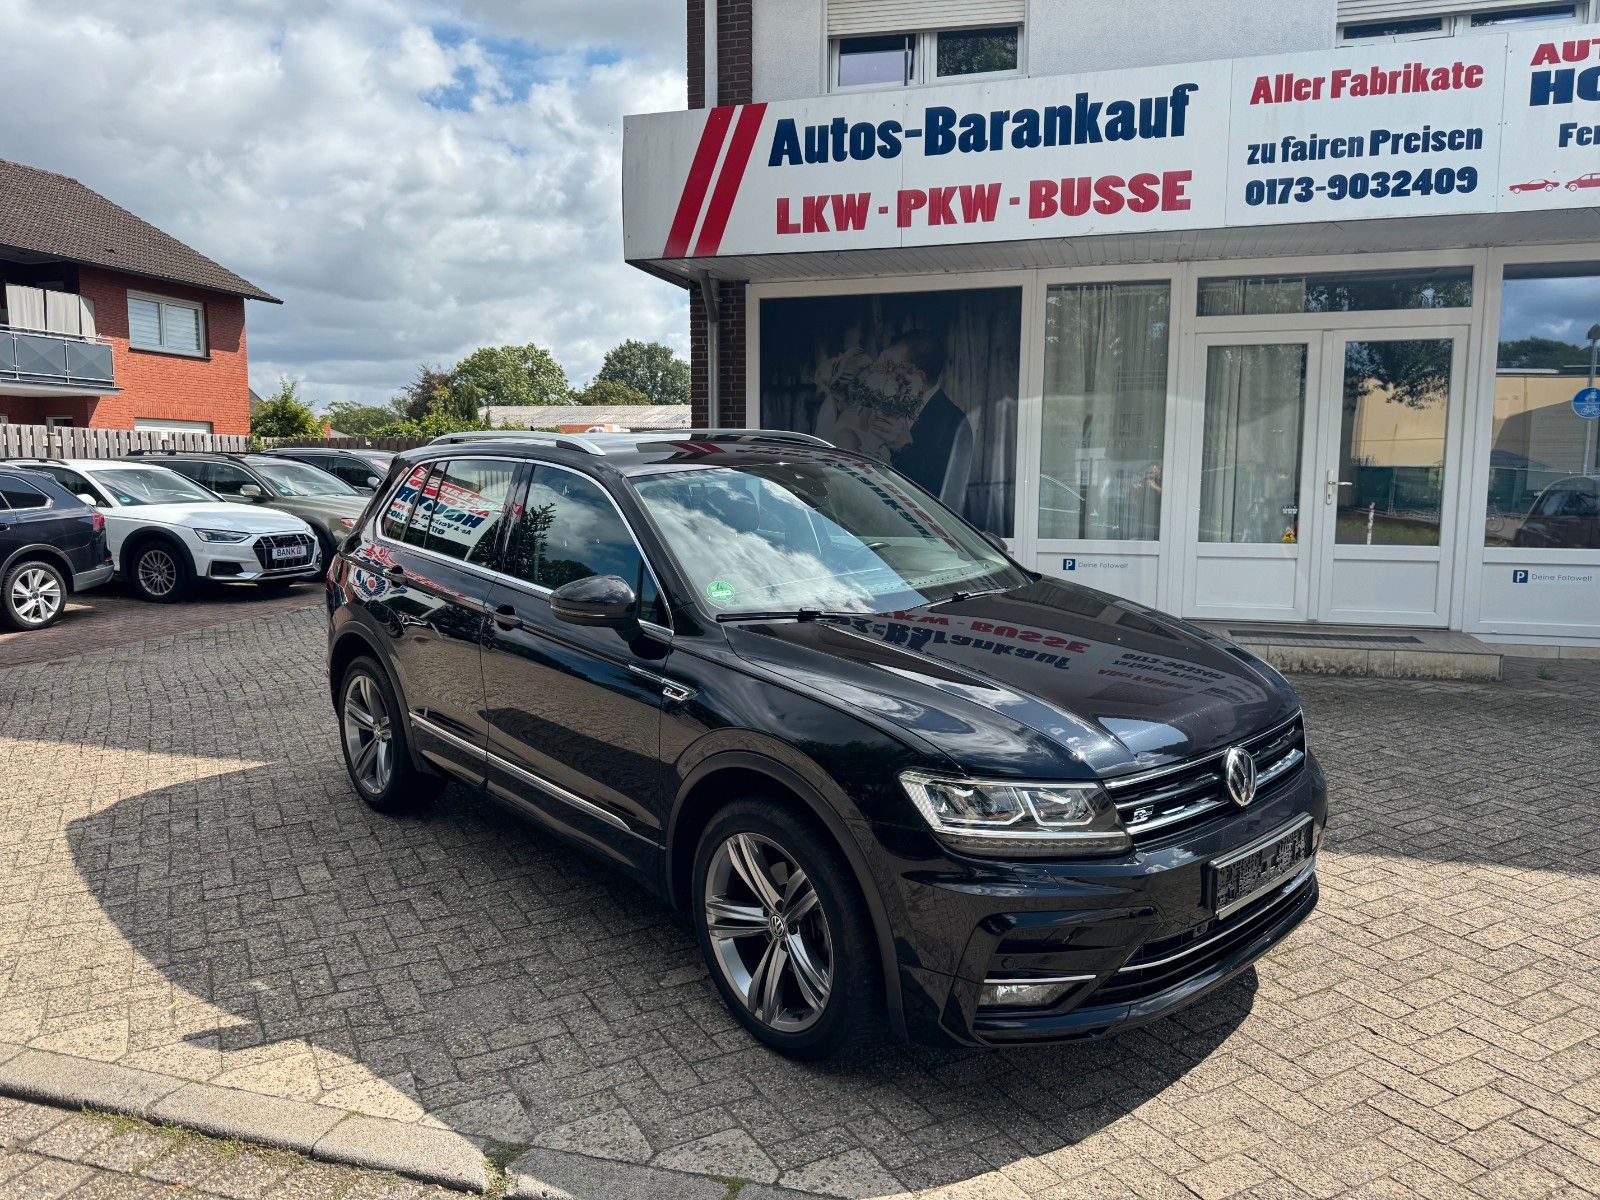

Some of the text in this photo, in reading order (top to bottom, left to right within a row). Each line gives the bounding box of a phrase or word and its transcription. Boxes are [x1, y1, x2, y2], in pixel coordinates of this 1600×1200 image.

[1250, 61, 1484, 105] Aller Fabrikate
[767, 83, 1199, 167] Autos-Barankauf
[1247, 125, 1483, 165] zu fairen Preisen
[776, 192, 871, 235] LKW
[896, 182, 1002, 228] PKW
[1029, 170, 1192, 220] BUSSE
[1245, 166, 1478, 206] 0173-9032409
[276, 547, 296, 557] BANK
[1531, 573, 1555, 581] Deine
